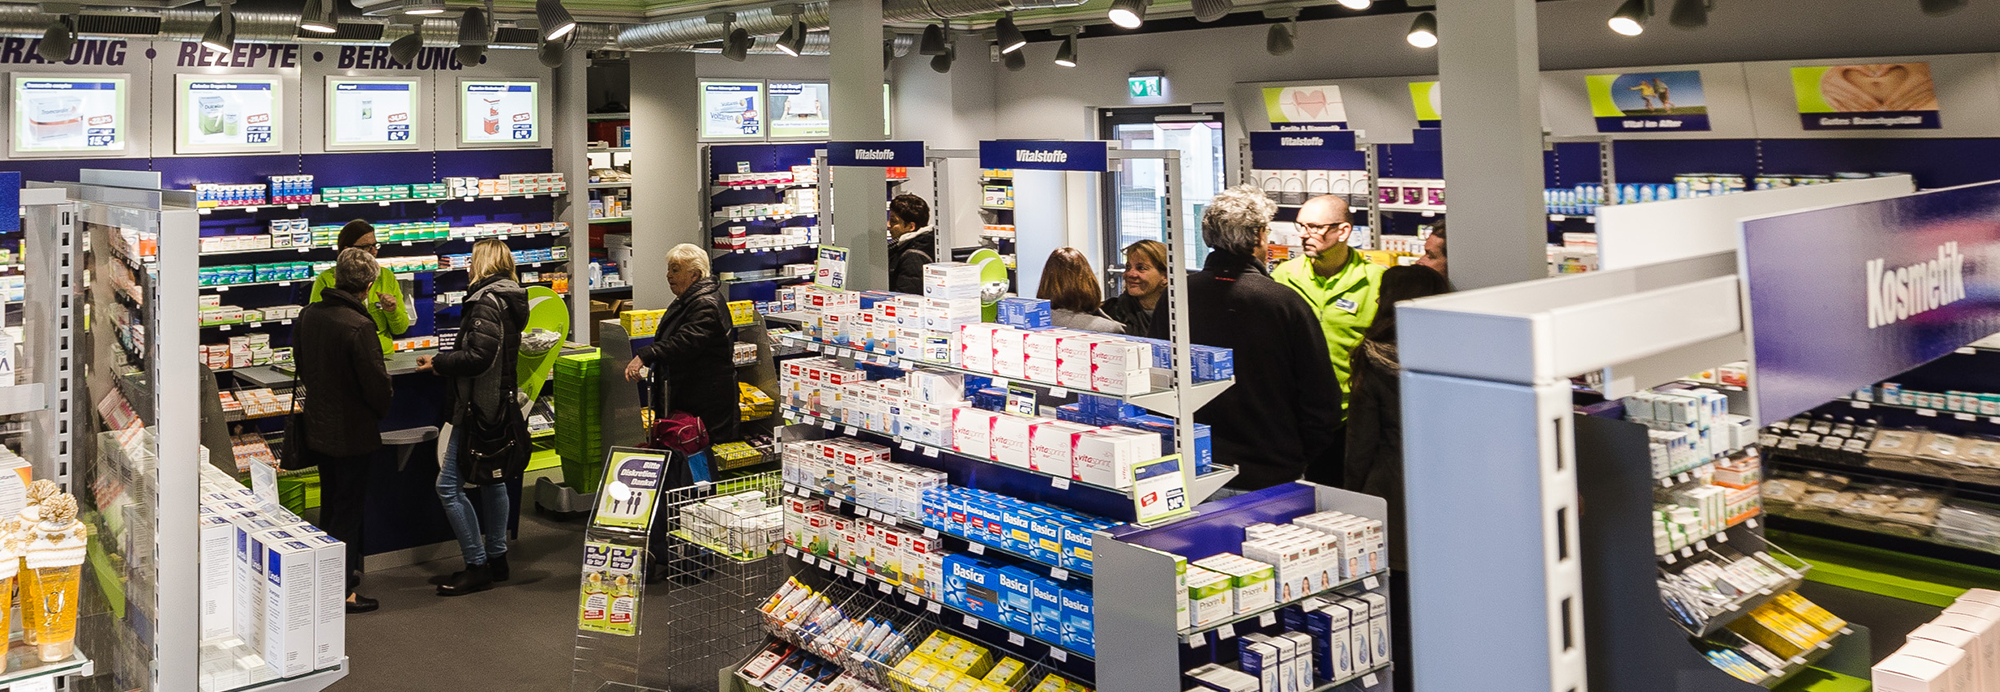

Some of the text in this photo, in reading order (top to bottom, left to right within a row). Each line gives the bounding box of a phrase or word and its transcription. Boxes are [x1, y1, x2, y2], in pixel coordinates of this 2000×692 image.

[0, 38, 127, 66] RAUNG
[1281, 136, 1324, 146] Vitalstoffe
[855, 149, 894, 160] Vitalstoffe
[1016, 150, 1068, 163] Vitalstoffe
[1866, 240, 1966, 329] Kosmetik
[1036, 444, 1066, 458] vitasprint
[1078, 453, 1111, 468] vitasprint
[631, 478, 656, 487] Danke!
[1003, 512, 1028, 528] Basica
[1031, 521, 1057, 537] Basica
[1064, 530, 1092, 546] Basica
[953, 562, 985, 584] Basica
[1000, 574, 1028, 594] Basica
[1242, 586, 1262, 598] Priorin
[1034, 586, 1057, 603] Basica
[1062, 596, 1089, 614] Basica
[1200, 598, 1220, 609] Priorin
